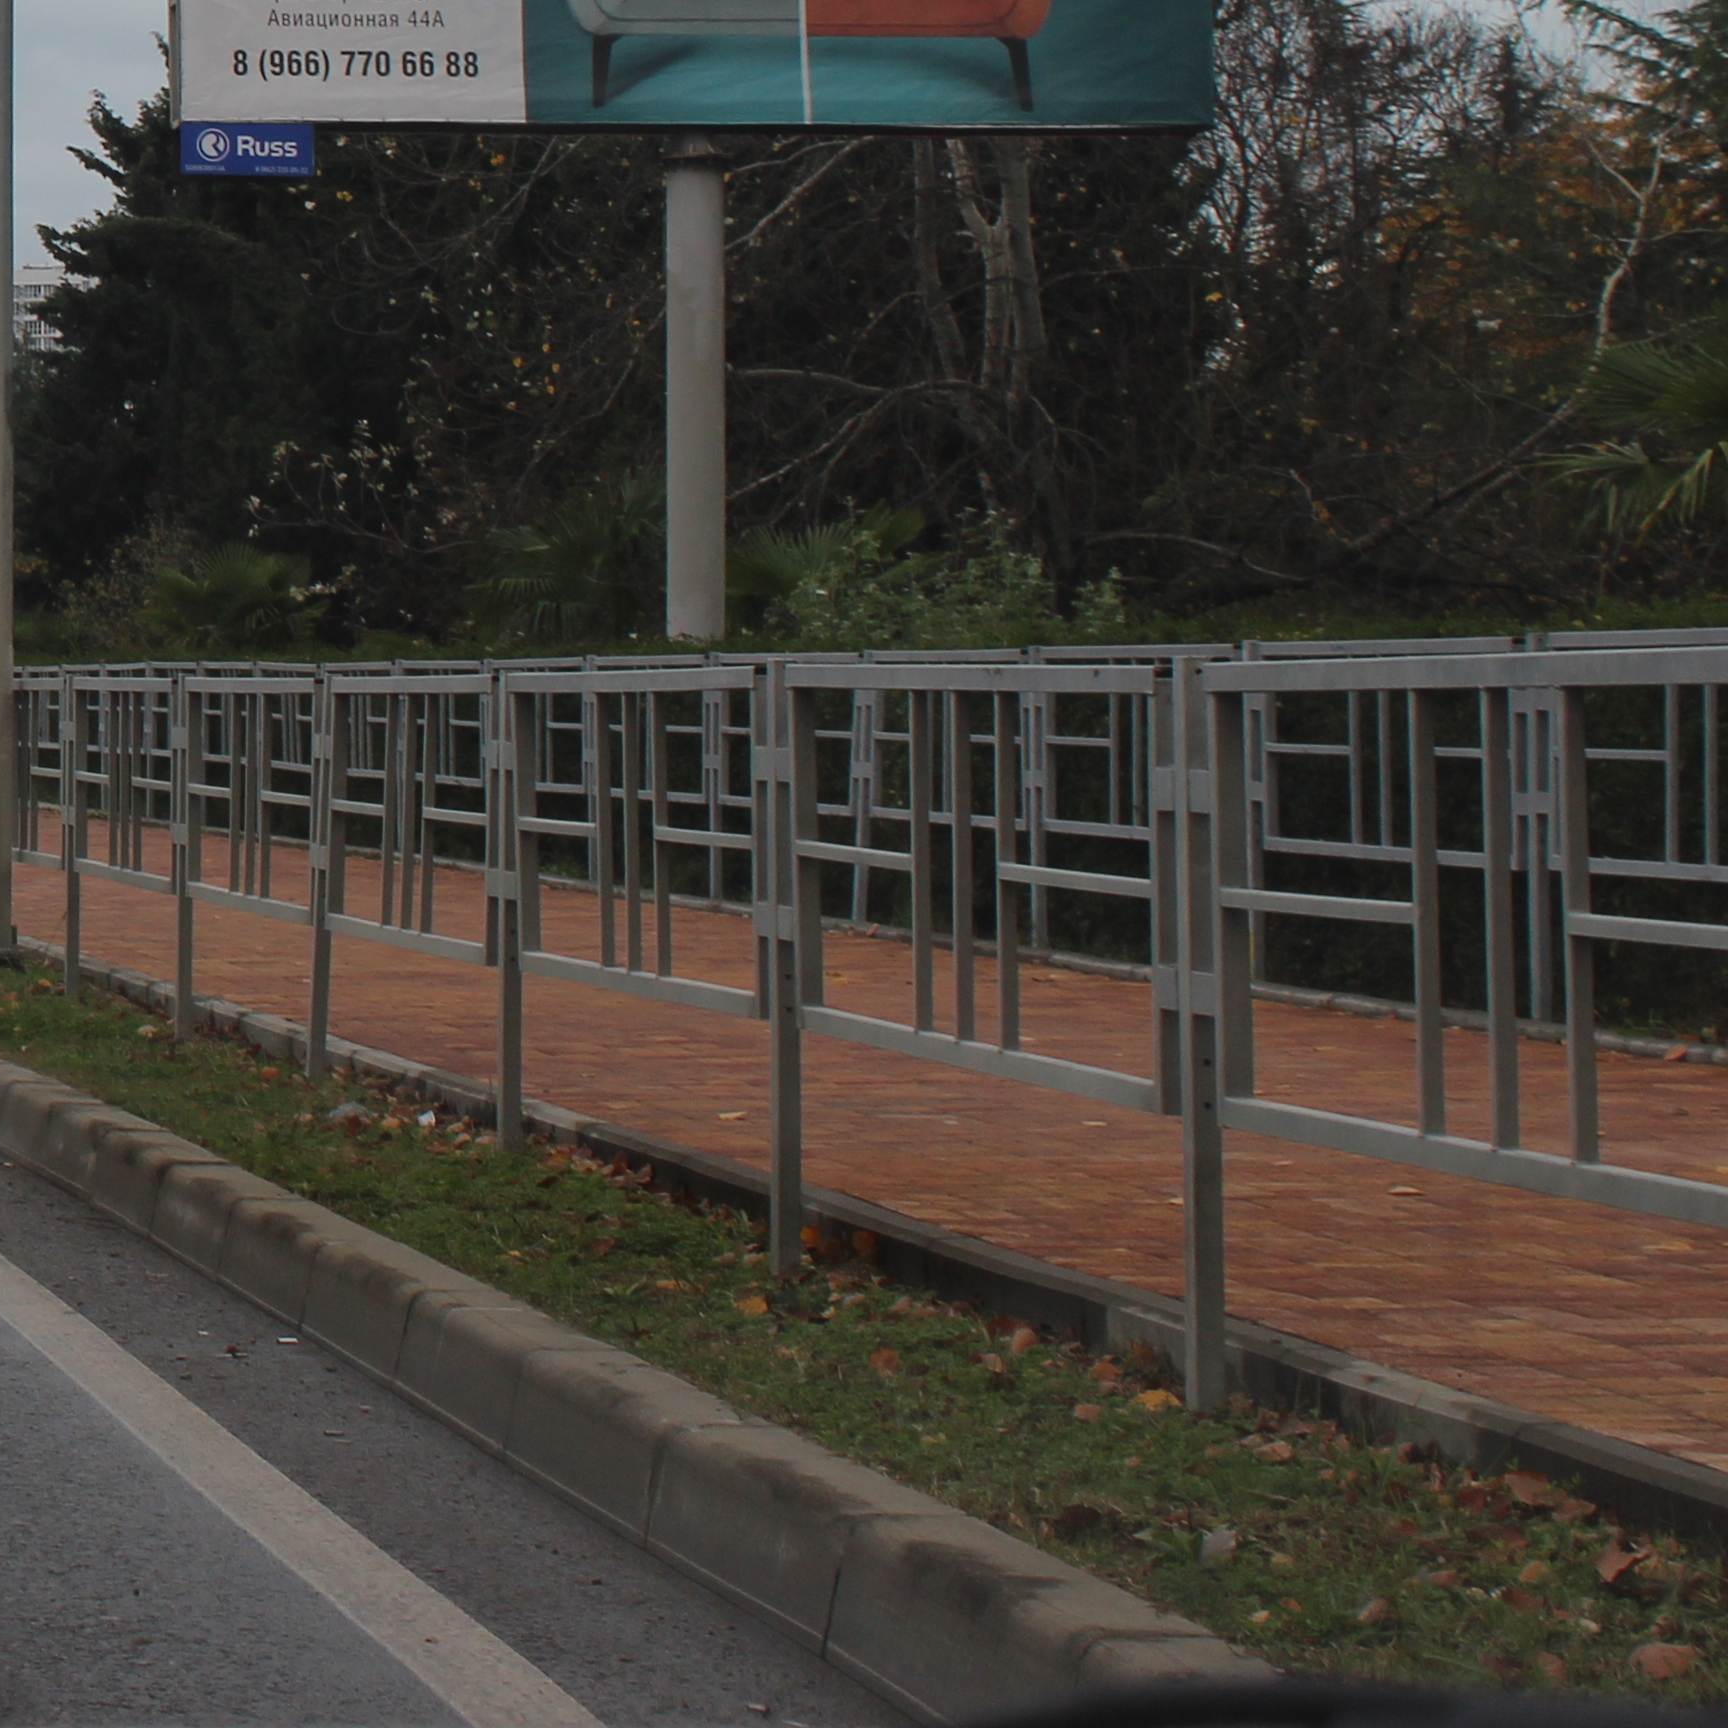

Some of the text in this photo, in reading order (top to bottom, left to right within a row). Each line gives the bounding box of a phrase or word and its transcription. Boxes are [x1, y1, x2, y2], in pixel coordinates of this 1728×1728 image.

[267, 9, 400, 30] Авиационная
[232, 48, 480, 83] 8 (966) 770 66 88
[236, 134, 299, 158] Russ
